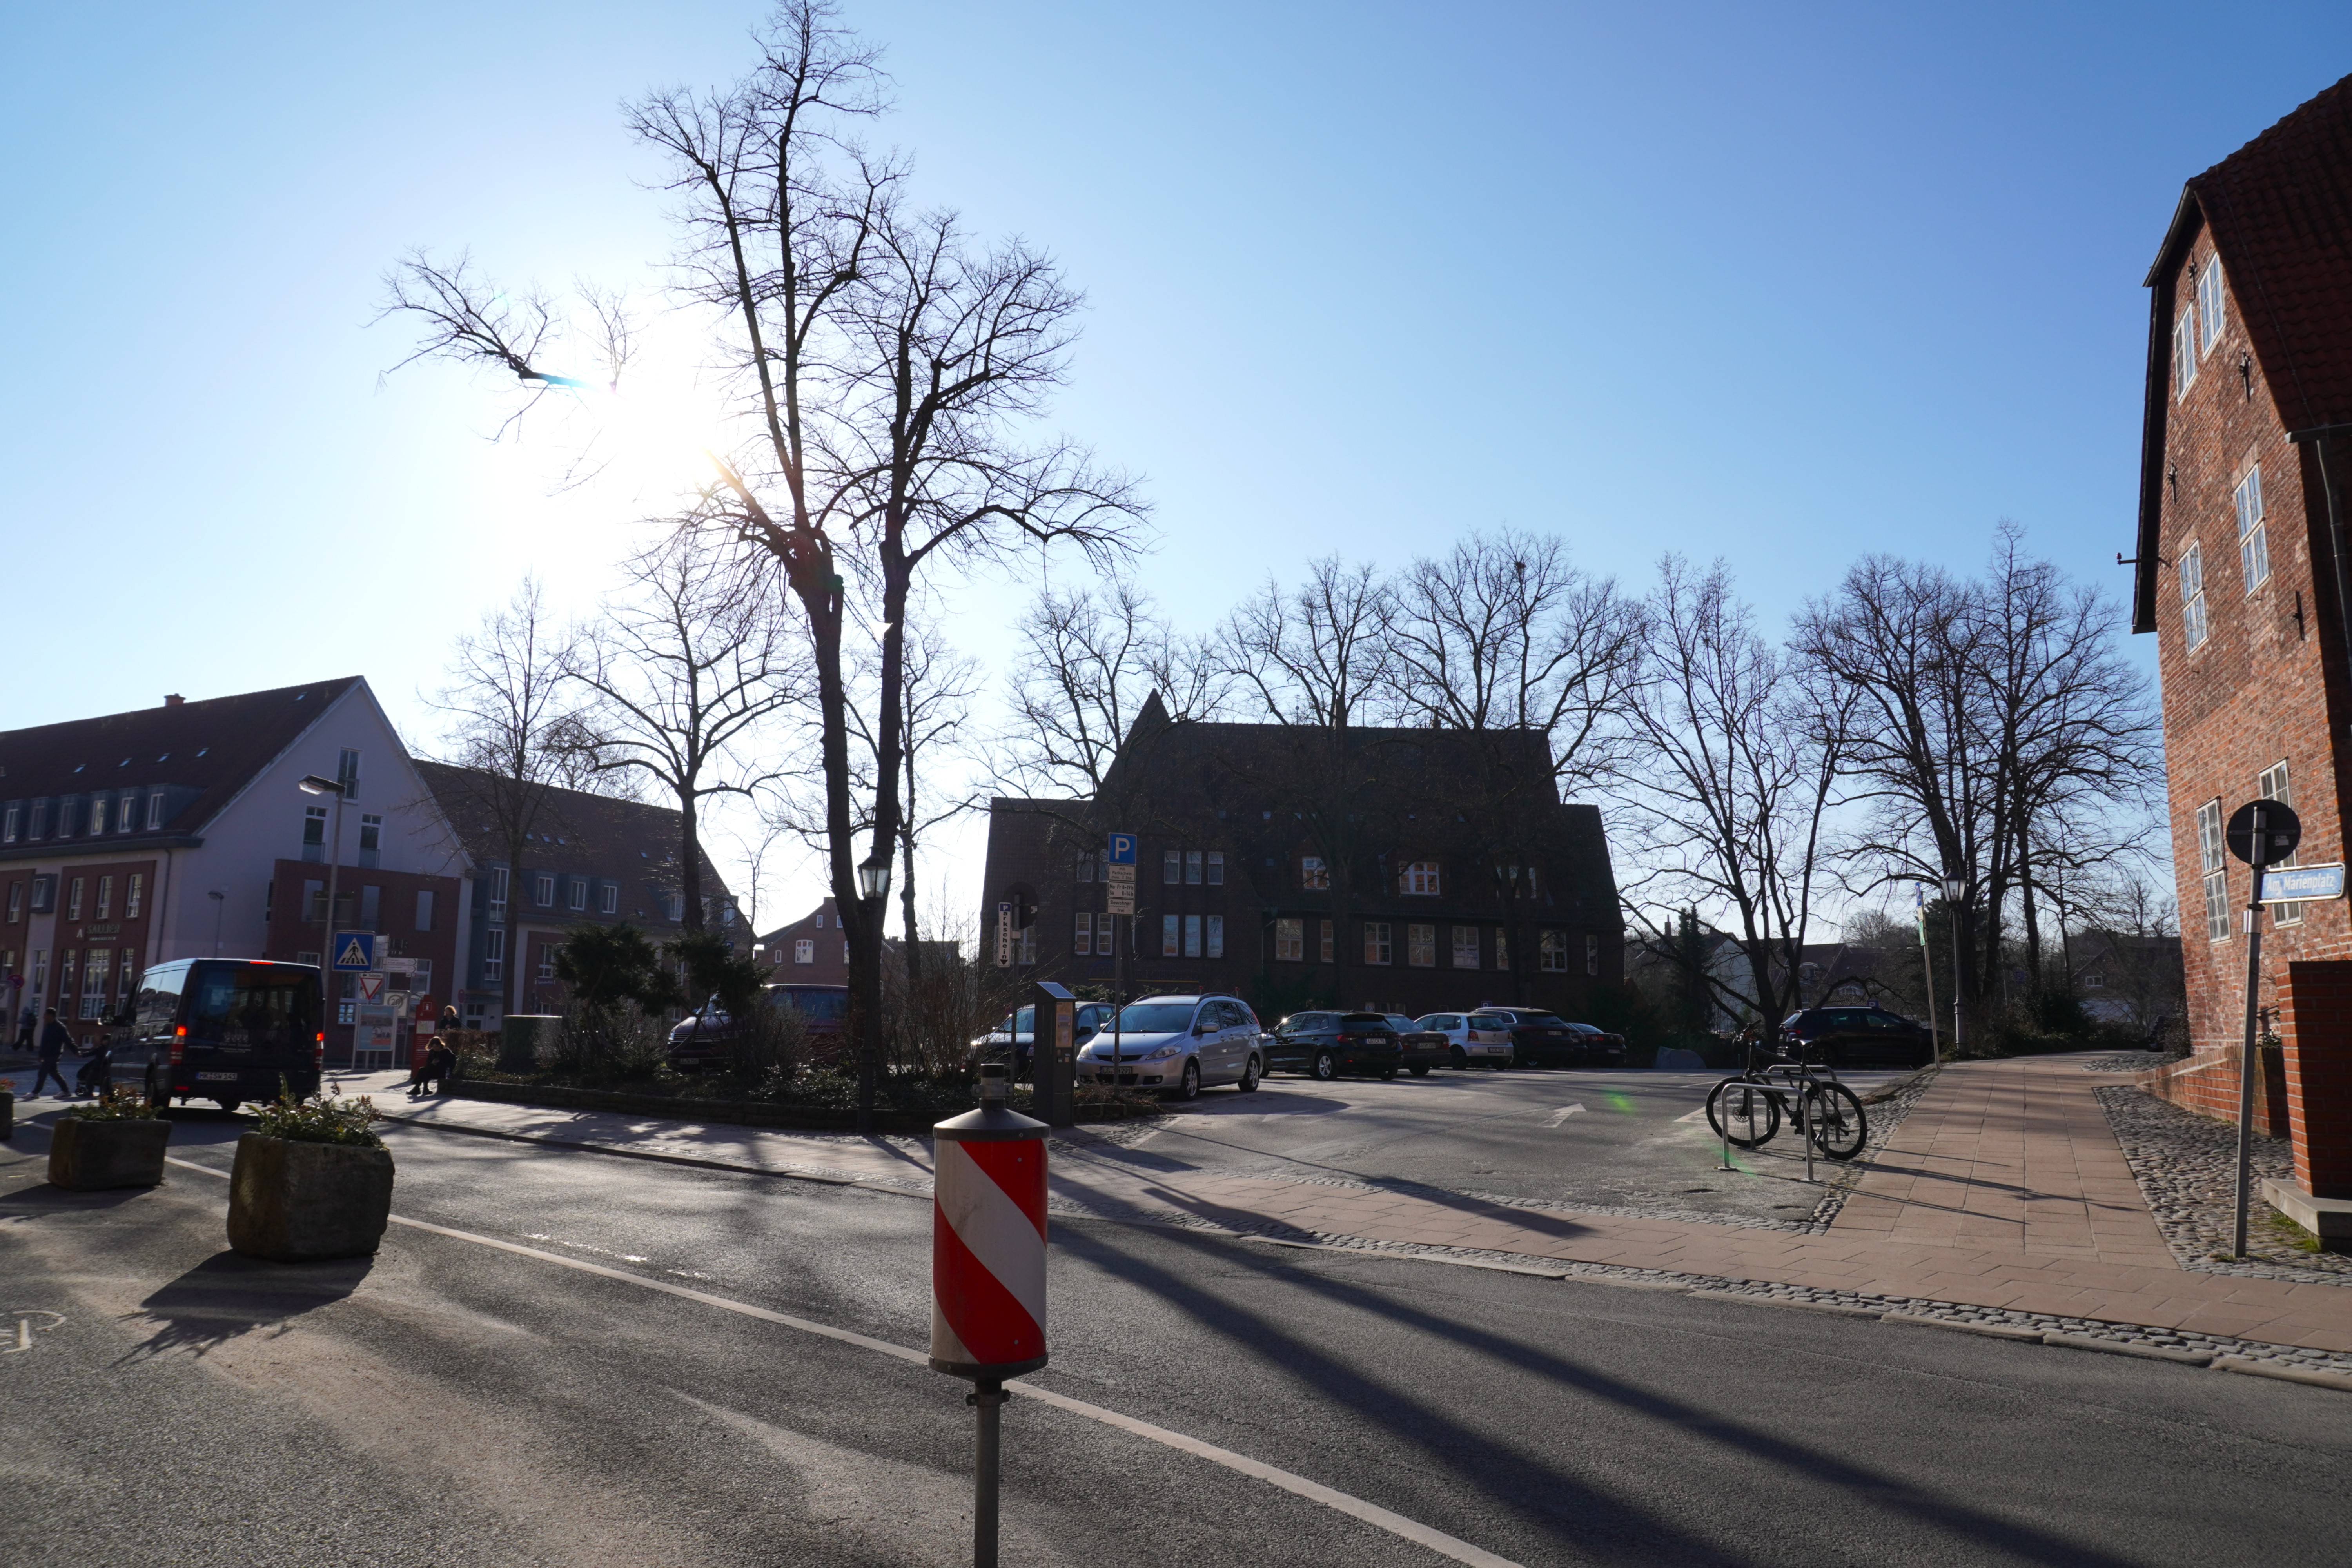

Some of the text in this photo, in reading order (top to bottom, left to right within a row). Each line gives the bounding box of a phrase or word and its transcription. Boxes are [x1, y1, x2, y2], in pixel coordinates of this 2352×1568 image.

[1115, 837, 1130, 860] P
[2267, 873, 2335, 893] Am Marienplatz
